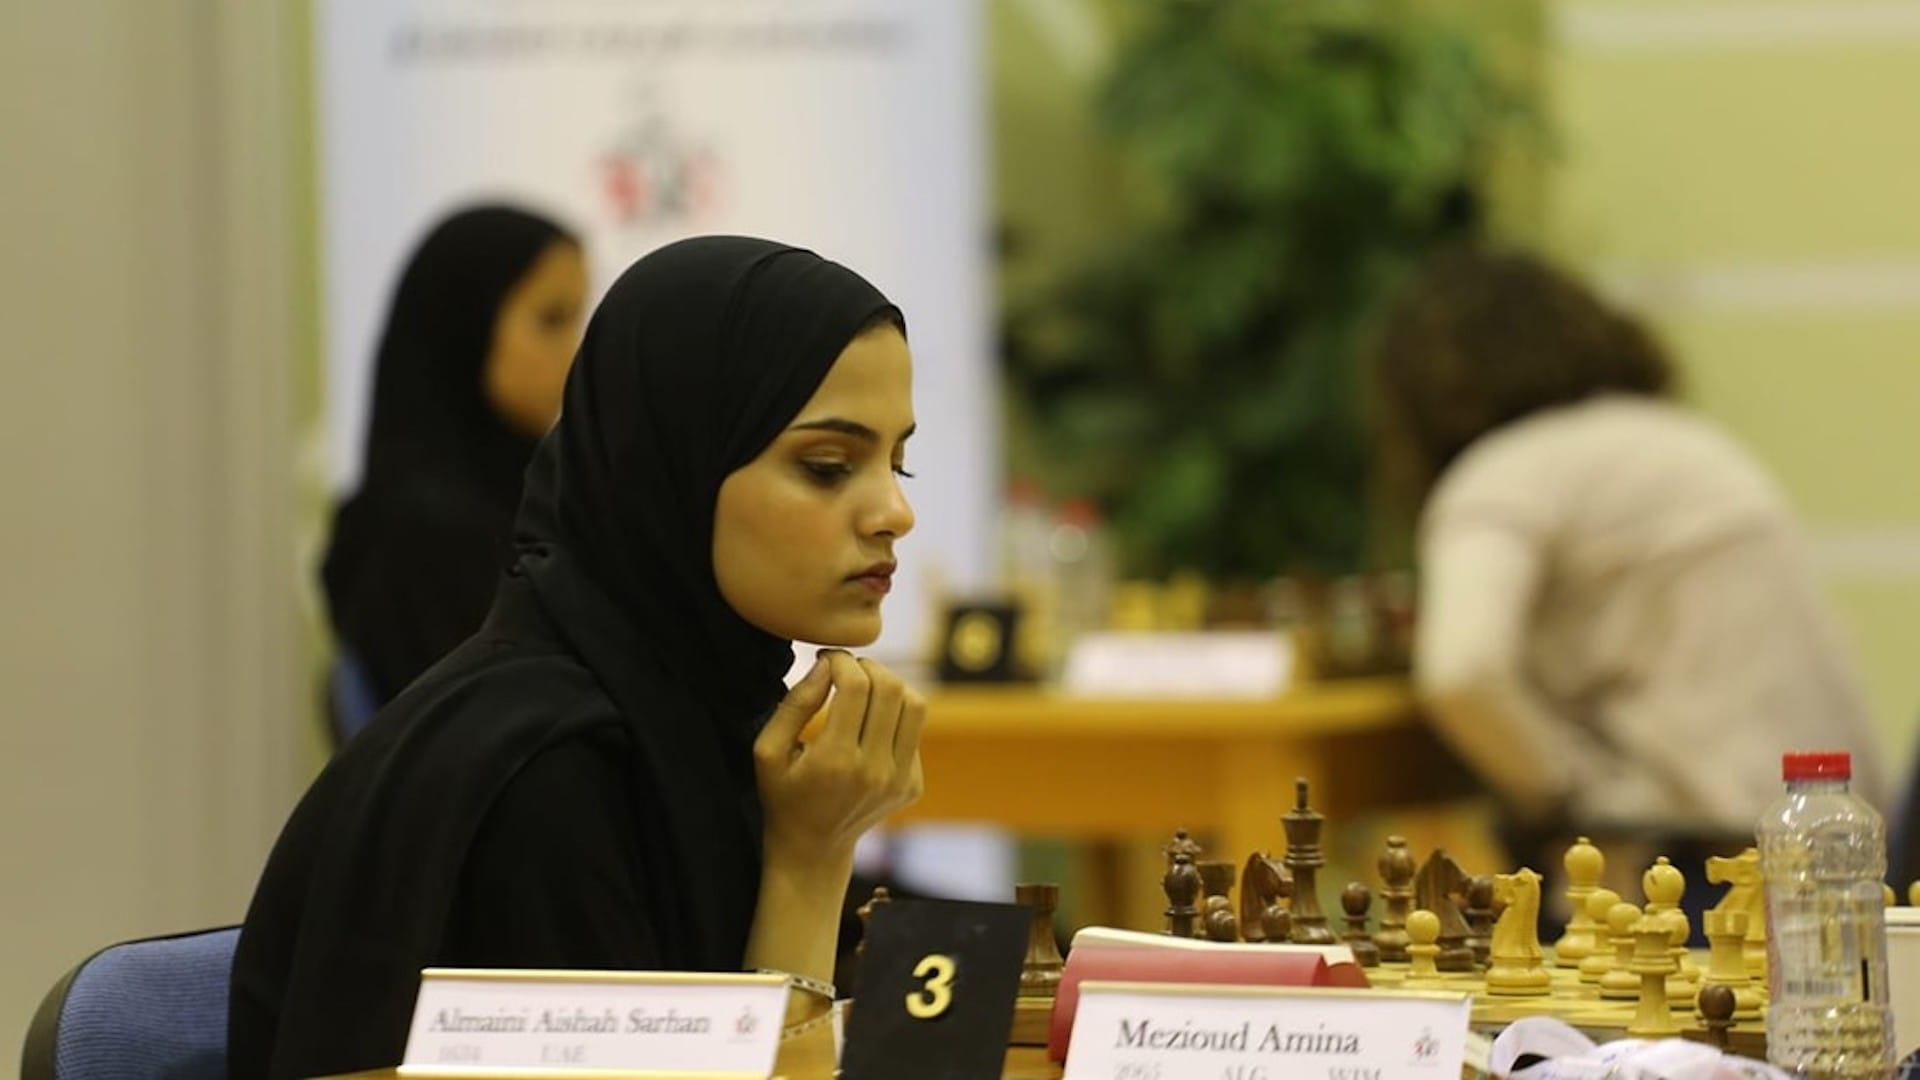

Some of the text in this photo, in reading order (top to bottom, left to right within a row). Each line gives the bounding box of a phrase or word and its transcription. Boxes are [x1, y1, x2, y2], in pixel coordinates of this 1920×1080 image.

[906, 954, 956, 1019] 3
[429, 1008, 712, 1035] Almaini Aishah Sarhan
[1115, 1018, 1361, 1054] Mezioud Amina
